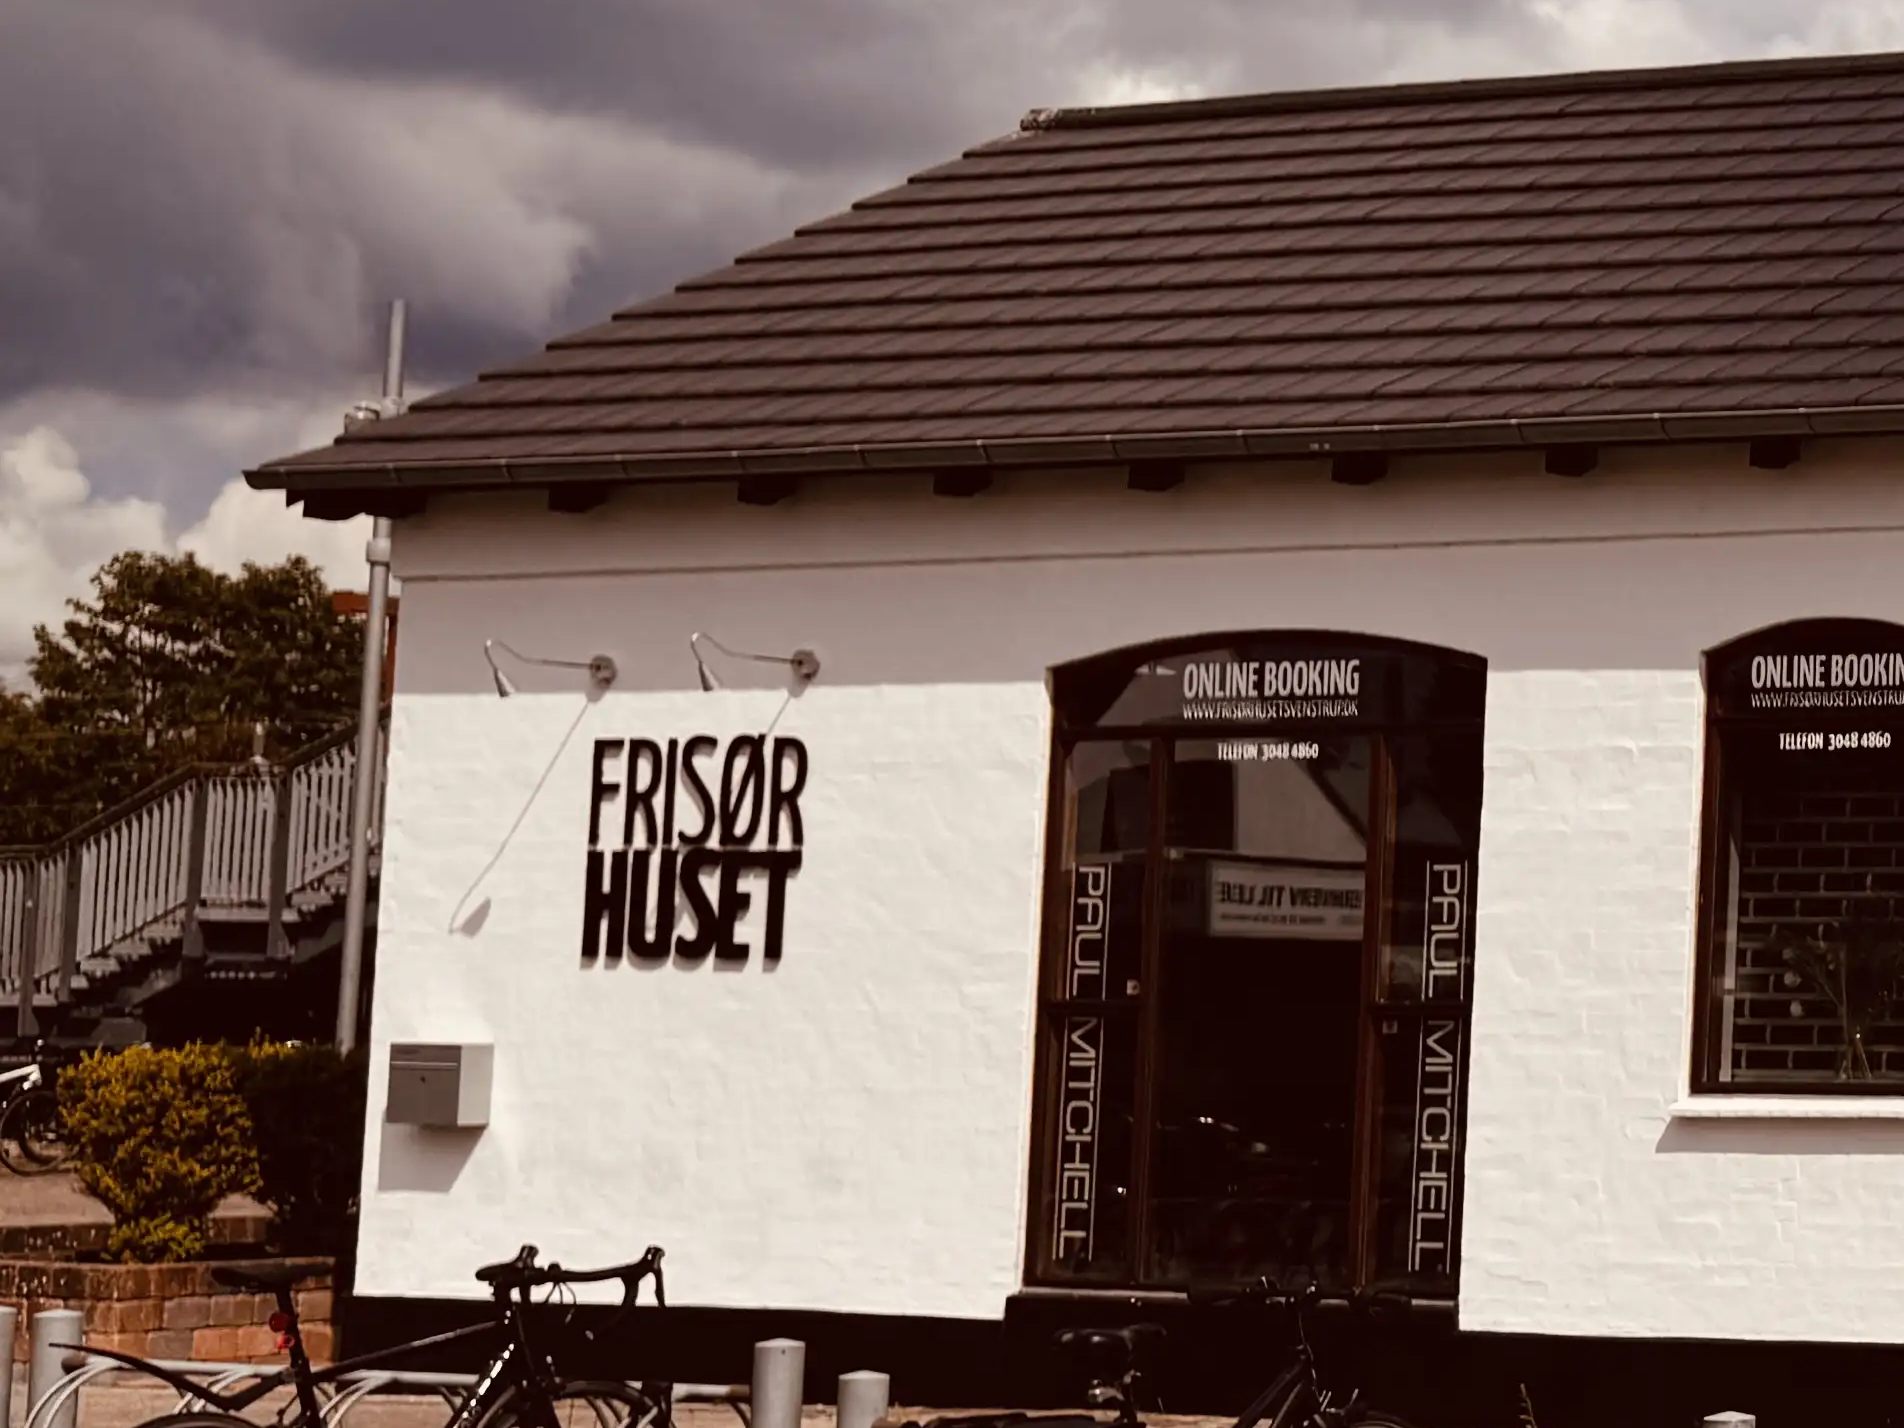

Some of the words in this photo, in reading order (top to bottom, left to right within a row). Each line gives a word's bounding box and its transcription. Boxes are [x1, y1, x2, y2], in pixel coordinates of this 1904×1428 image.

[1184, 663, 1259, 698] ONLINE
[1264, 660, 1359, 696] BOOKING
[1752, 655, 1826, 688] ONLINE
[589, 734, 808, 847] FRISØR
[1219, 743, 1258, 760] TELEFON
[1262, 744, 1289, 761] 3048
[1291, 743, 1318, 758] 4860
[1780, 732, 1823, 750] TELEFON
[1828, 732, 1858, 750] 3048
[1861, 731, 1891, 748] 4860
[581, 847, 803, 962] HUSET
[1072, 865, 1106, 997] PAUL
[1429, 864, 1462, 998] PAUL
[1058, 1016, 1098, 1259] MITCHELL
[1414, 1020, 1455, 1272] MITCHELL
